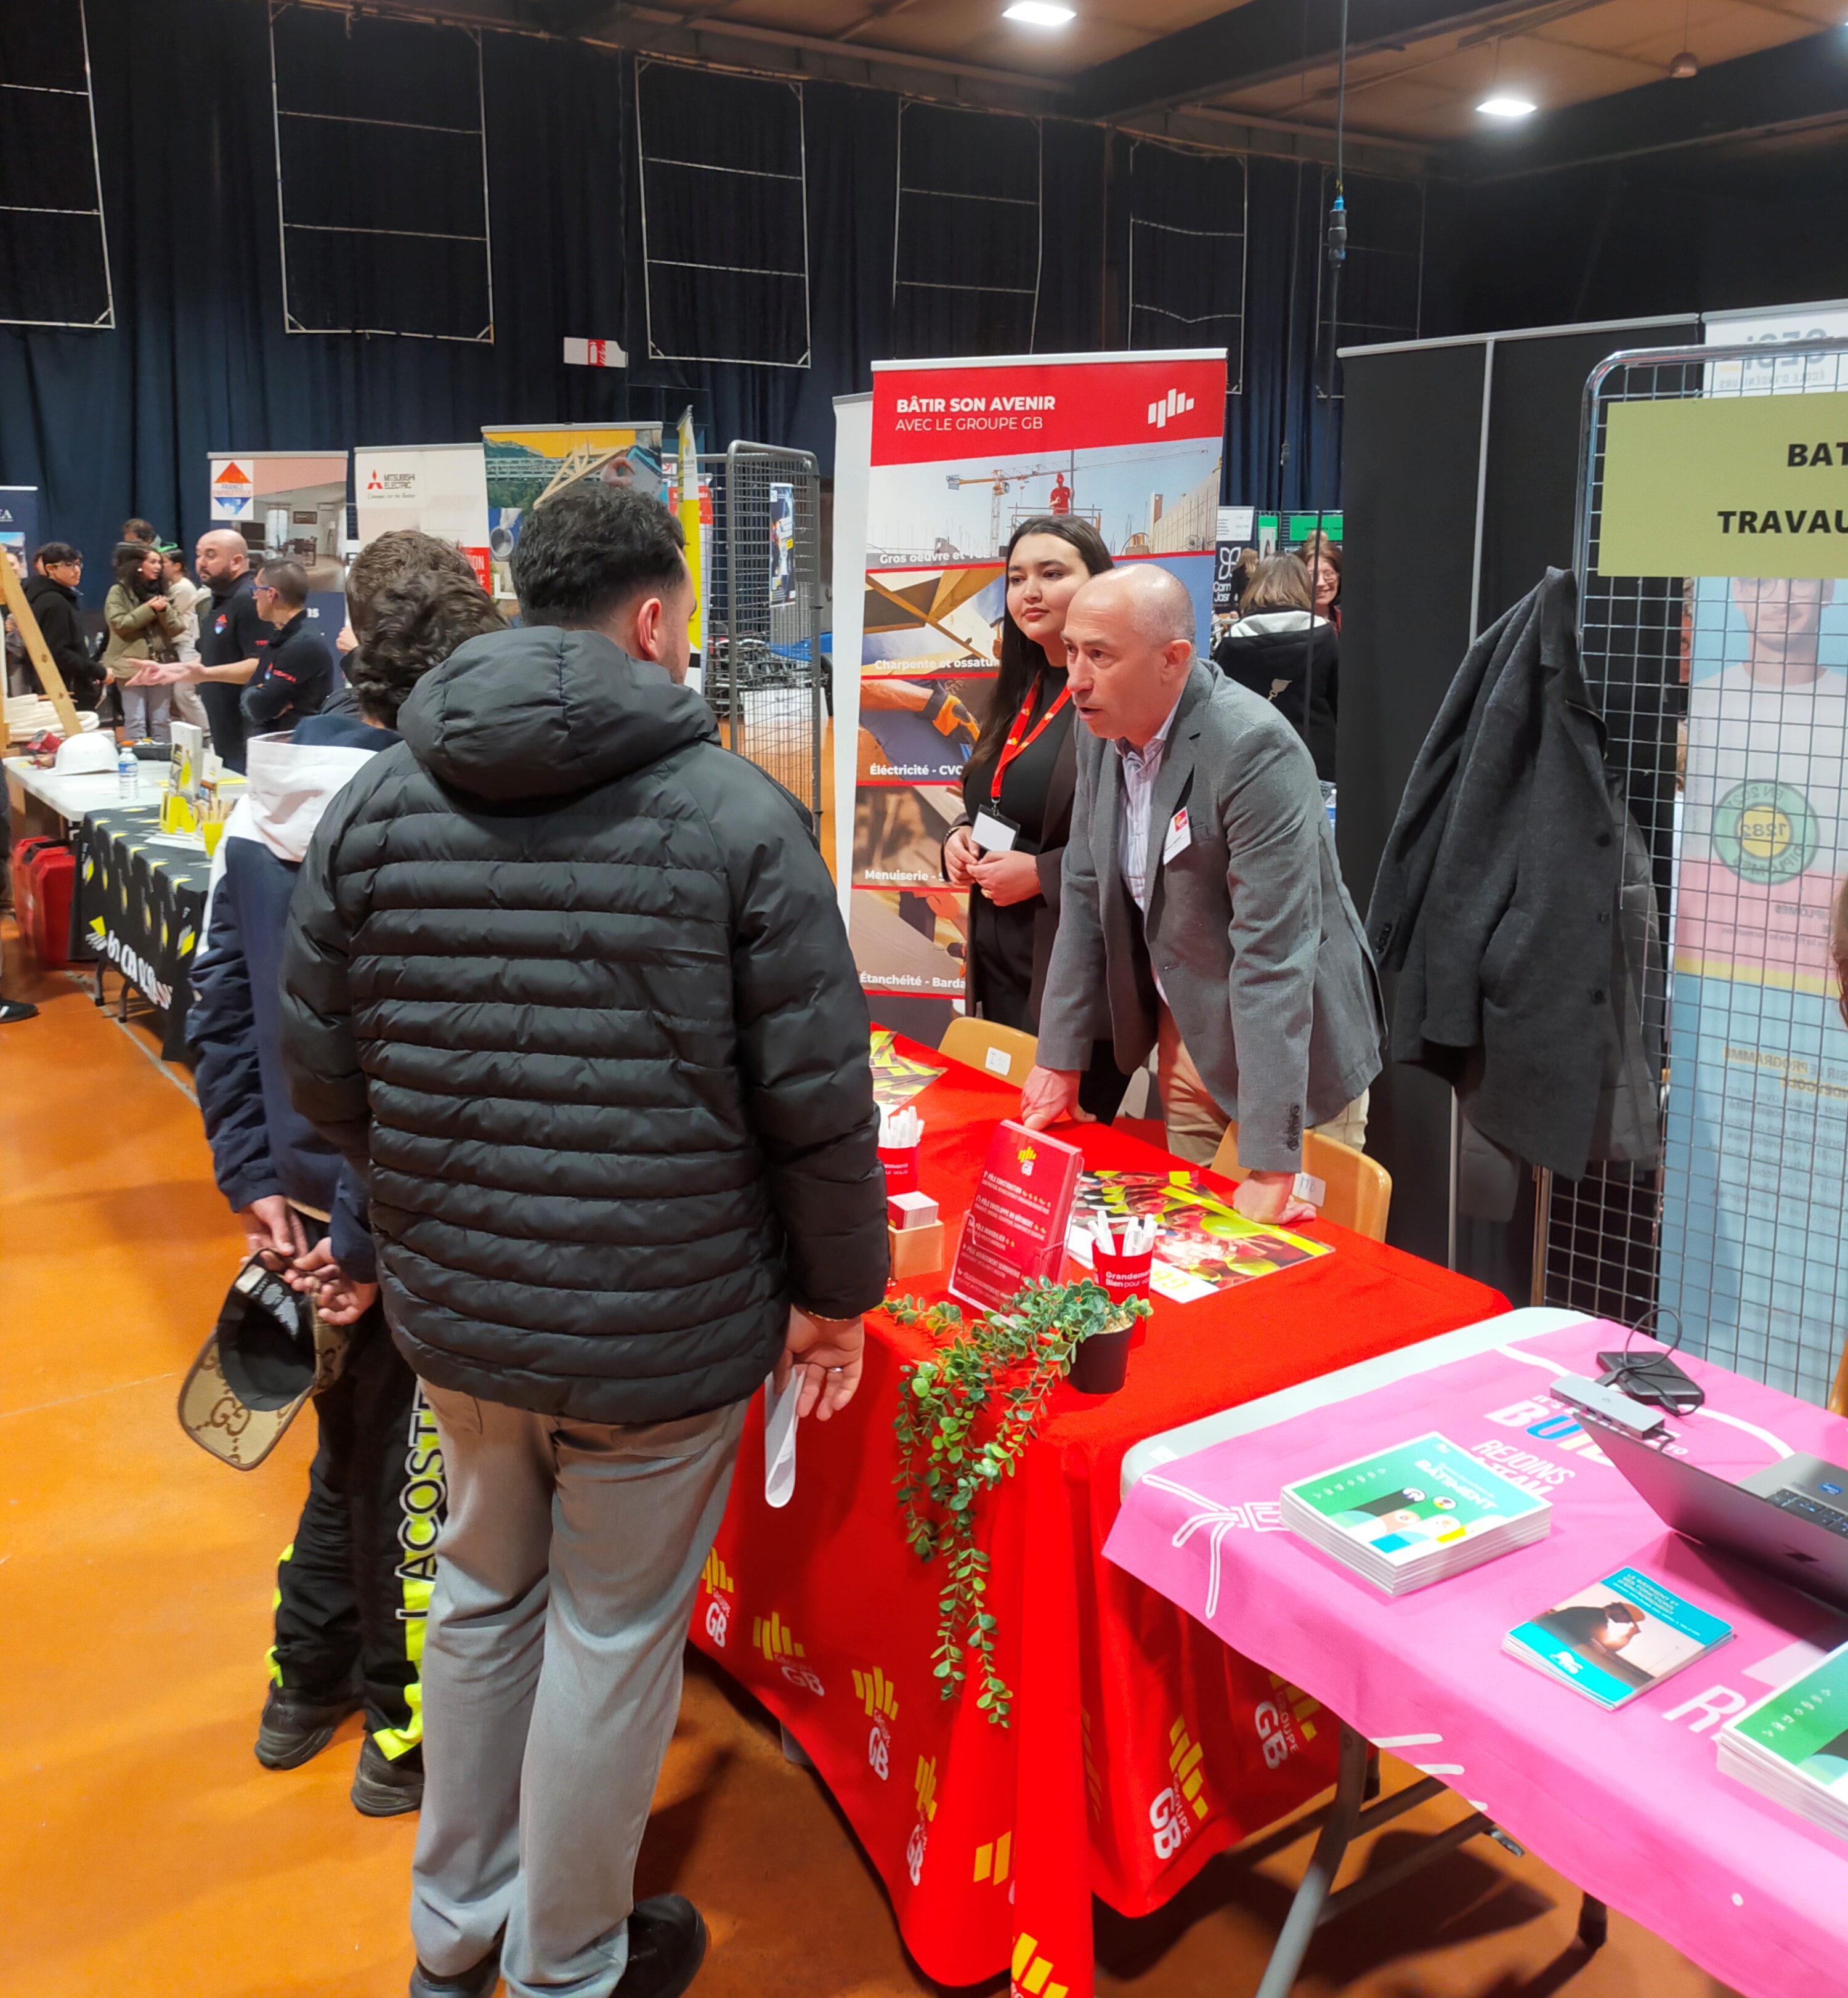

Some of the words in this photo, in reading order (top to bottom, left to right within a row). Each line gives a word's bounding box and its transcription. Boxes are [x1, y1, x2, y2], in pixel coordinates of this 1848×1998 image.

[896, 396, 945, 413] BÂTIR
[949, 398, 986, 412] SON
[990, 396, 1055, 412] AVENIR
[895, 418, 933, 431] AVEC
[936, 418, 952, 431] LE
[955, 417, 1018, 431] GROUPE
[1021, 416, 1044, 430] GB
[1717, 510, 1848, 534] TRAVAU
[880, 553, 907, 564] Gros
[909, 553, 949, 562] oeuvre
[875, 660, 936, 671] Charpente
[939, 660, 951, 668] et
[870, 763, 929, 776] Éléctricité
[939, 765, 963, 776] CVC
[865, 870, 928, 882] Menuiserie
[859, 971, 922, 986] Étanchéité
[1021, 1163, 1034, 1176] GB
[1106, 1279, 1124, 1288] Bien
[1124, 1280, 1141, 1288] pour
[1471, 1439, 1576, 1485] REJOINS
[1414, 1458, 1499, 1509] BÂTIMENT
[706, 1602, 726, 1648] GB
[781, 1666, 825, 1696] GB
[1255, 1701, 1288, 1769] GB
[869, 1727, 889, 1781] GB
[1149, 1787, 1181, 1859] GB
